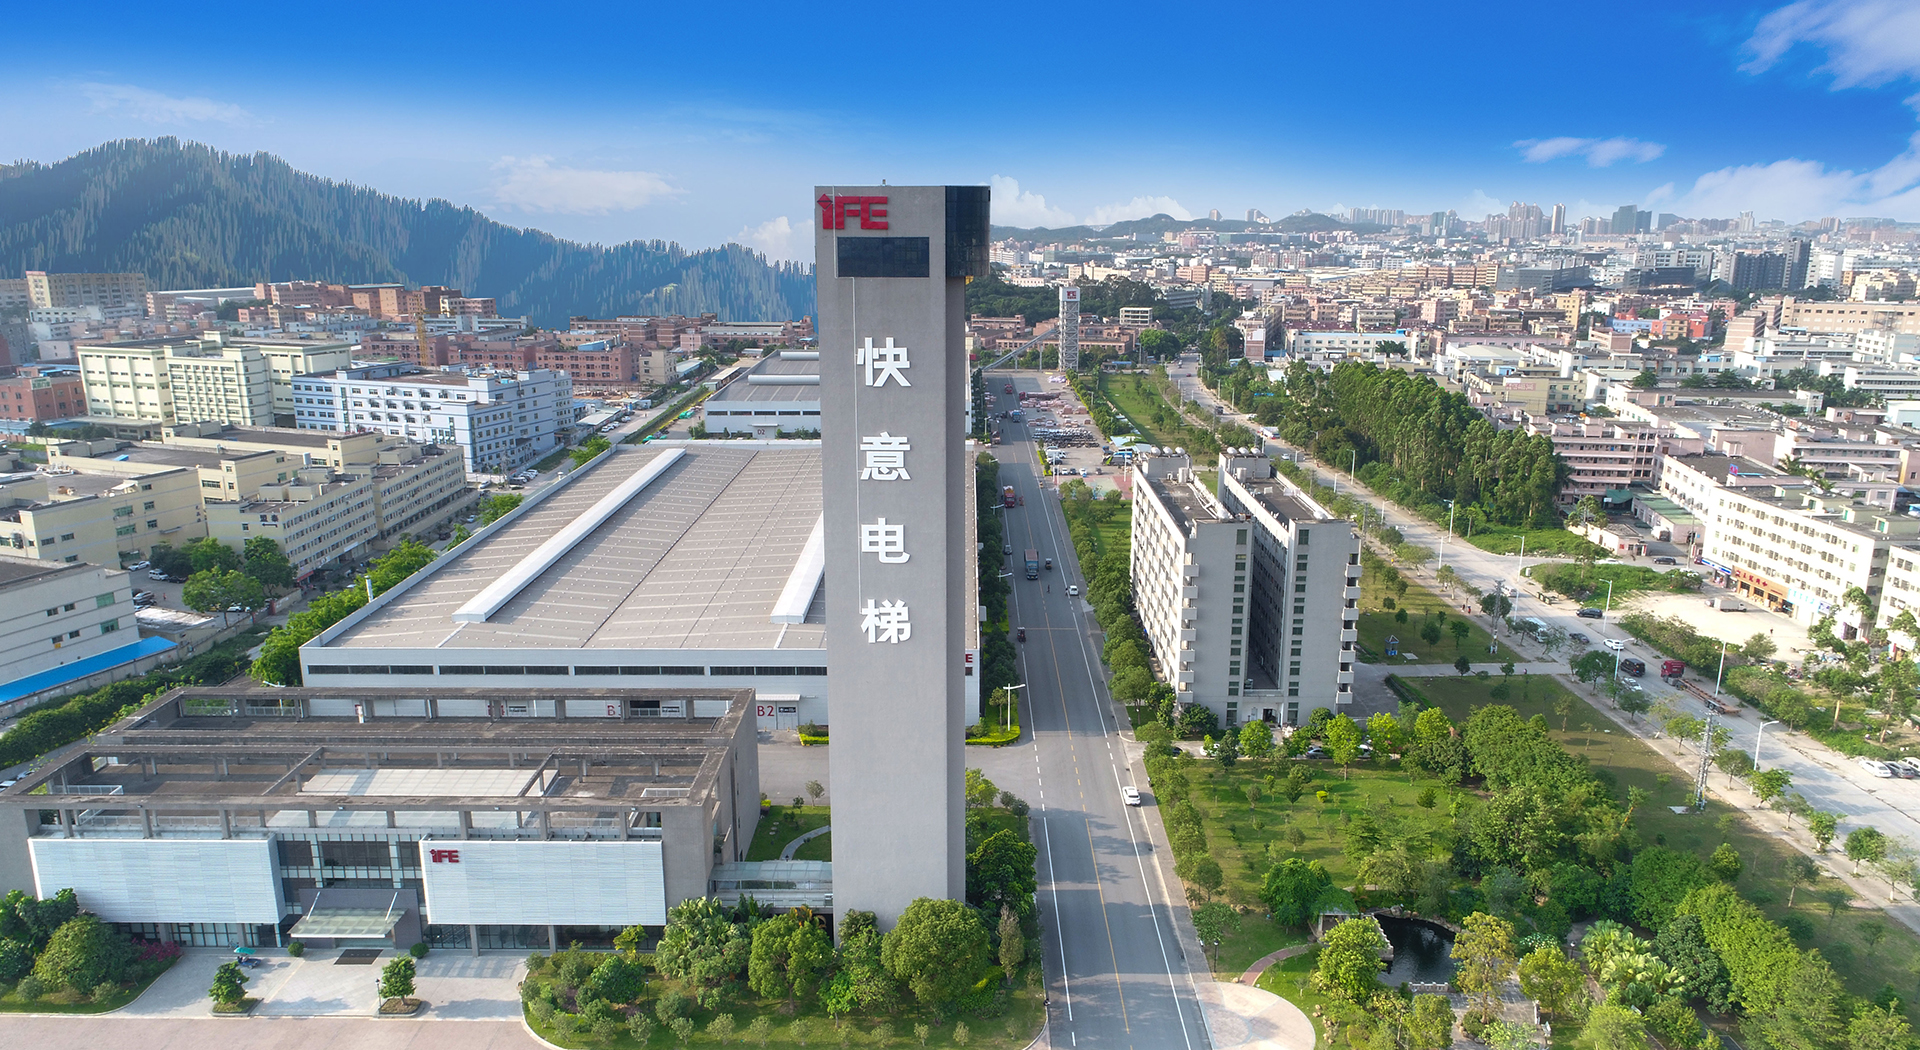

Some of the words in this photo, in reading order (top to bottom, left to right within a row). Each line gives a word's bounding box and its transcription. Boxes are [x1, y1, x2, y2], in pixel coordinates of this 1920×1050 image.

[856, 336, 912, 644] 快意电梯
[757, 705, 775, 717] B2
